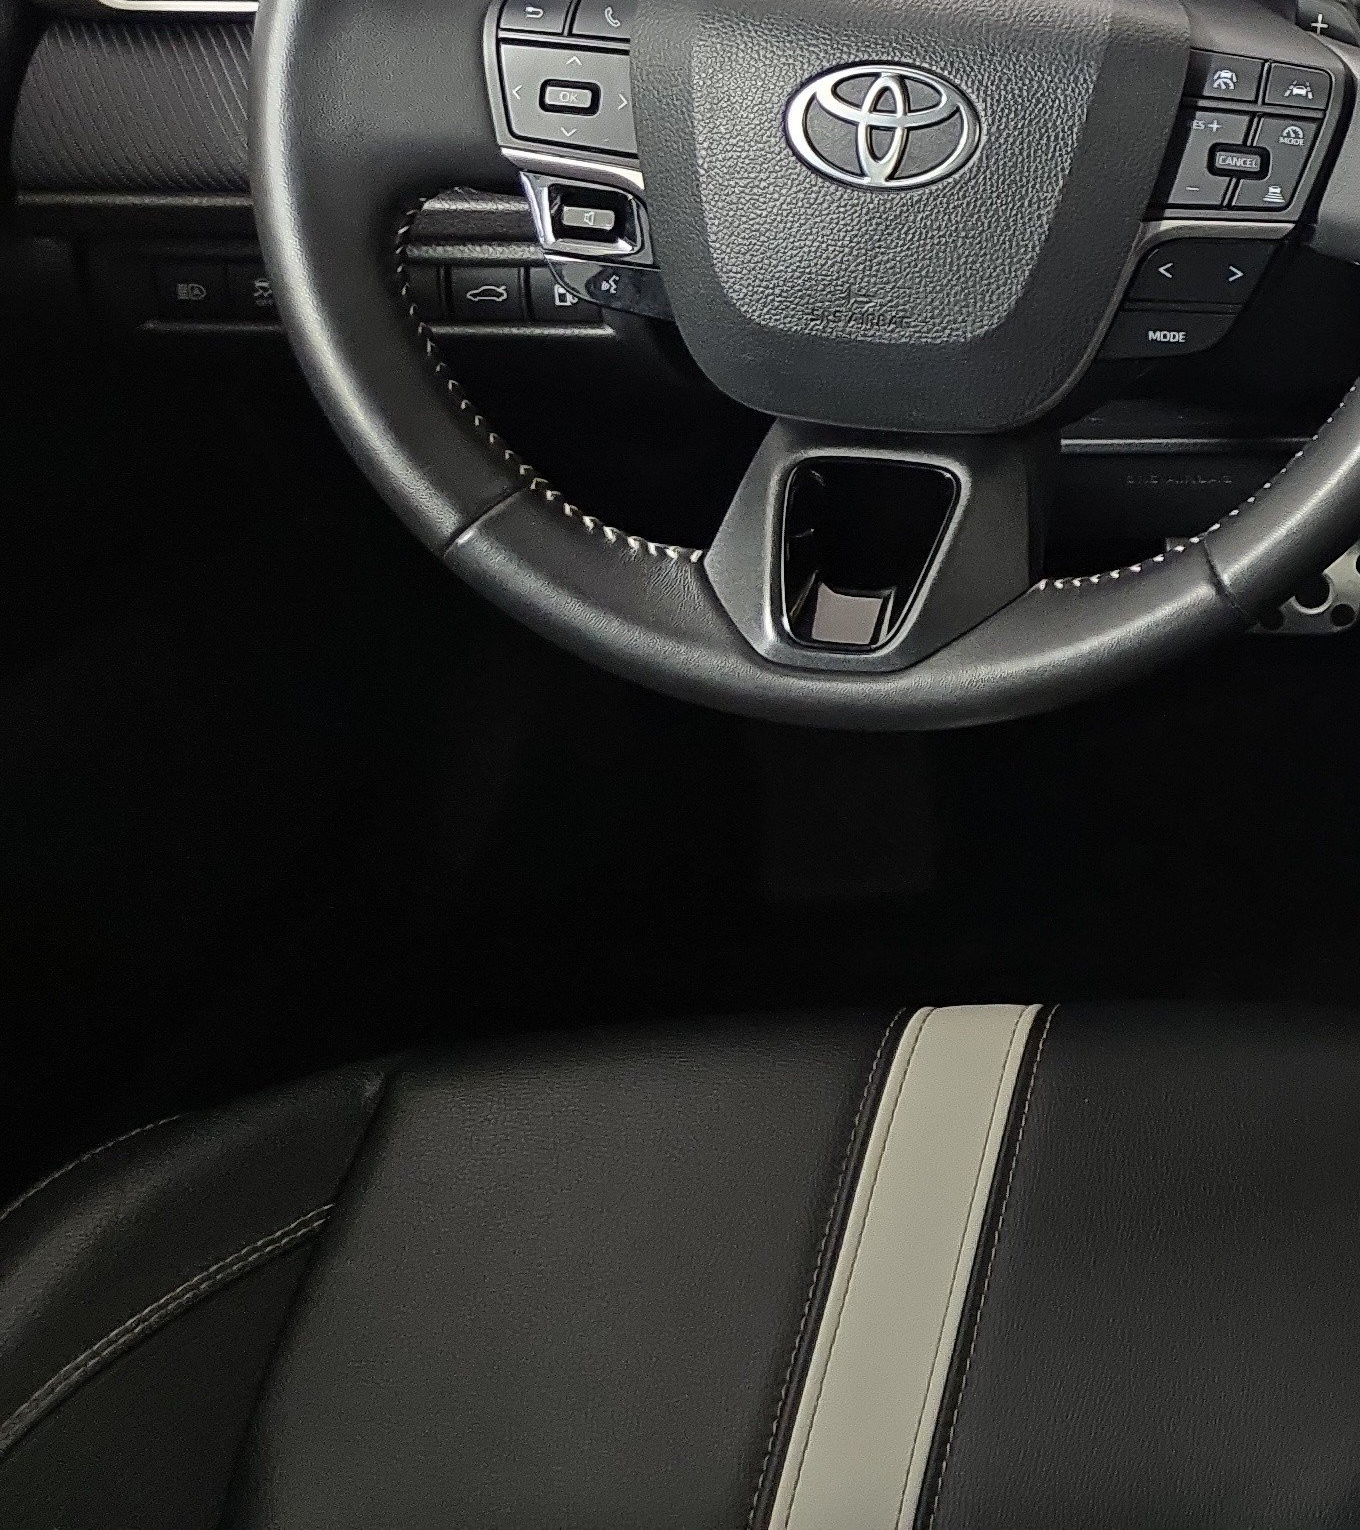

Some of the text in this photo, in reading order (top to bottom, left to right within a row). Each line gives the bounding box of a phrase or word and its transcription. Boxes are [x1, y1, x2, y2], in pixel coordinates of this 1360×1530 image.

[559, 91, 579, 104] OK
[1279, 136, 1305, 146] MODE
[1219, 155, 1258, 168] CANCEL
[1147, 330, 1187, 343] MODE
